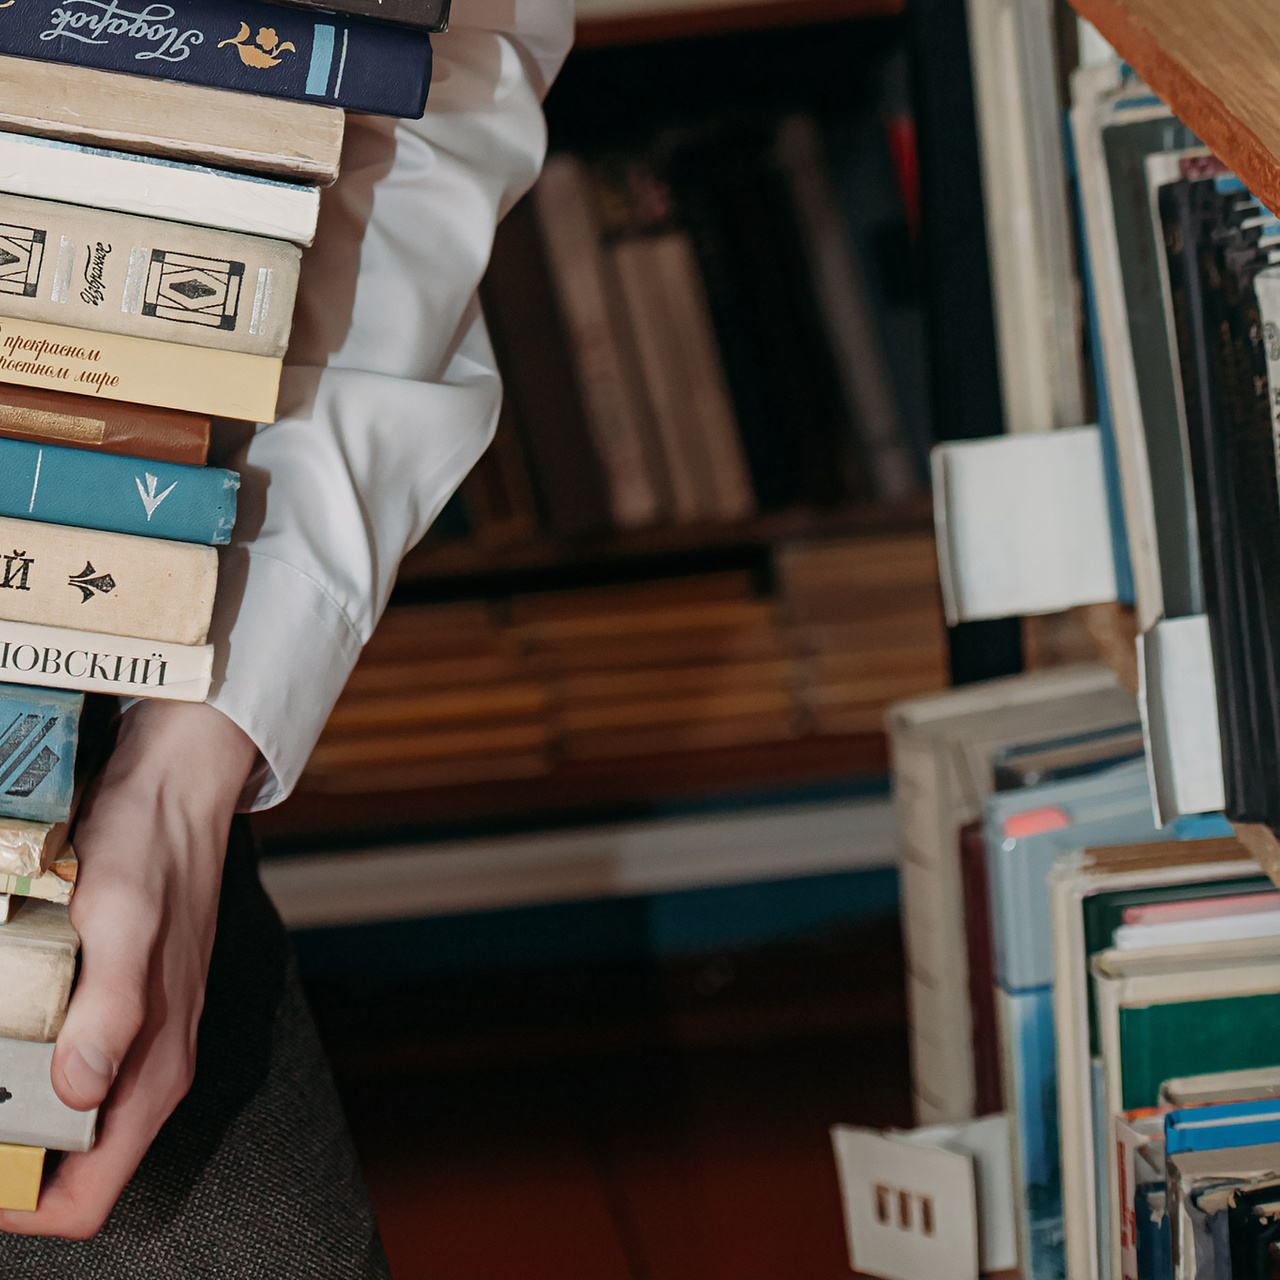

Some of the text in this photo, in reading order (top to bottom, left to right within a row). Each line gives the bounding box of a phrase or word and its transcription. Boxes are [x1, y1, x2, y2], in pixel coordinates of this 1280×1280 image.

[79, 241, 116, 307] Избранное
[2, 332, 102, 364] прекрасном
[72, 367, 121, 391] мире
